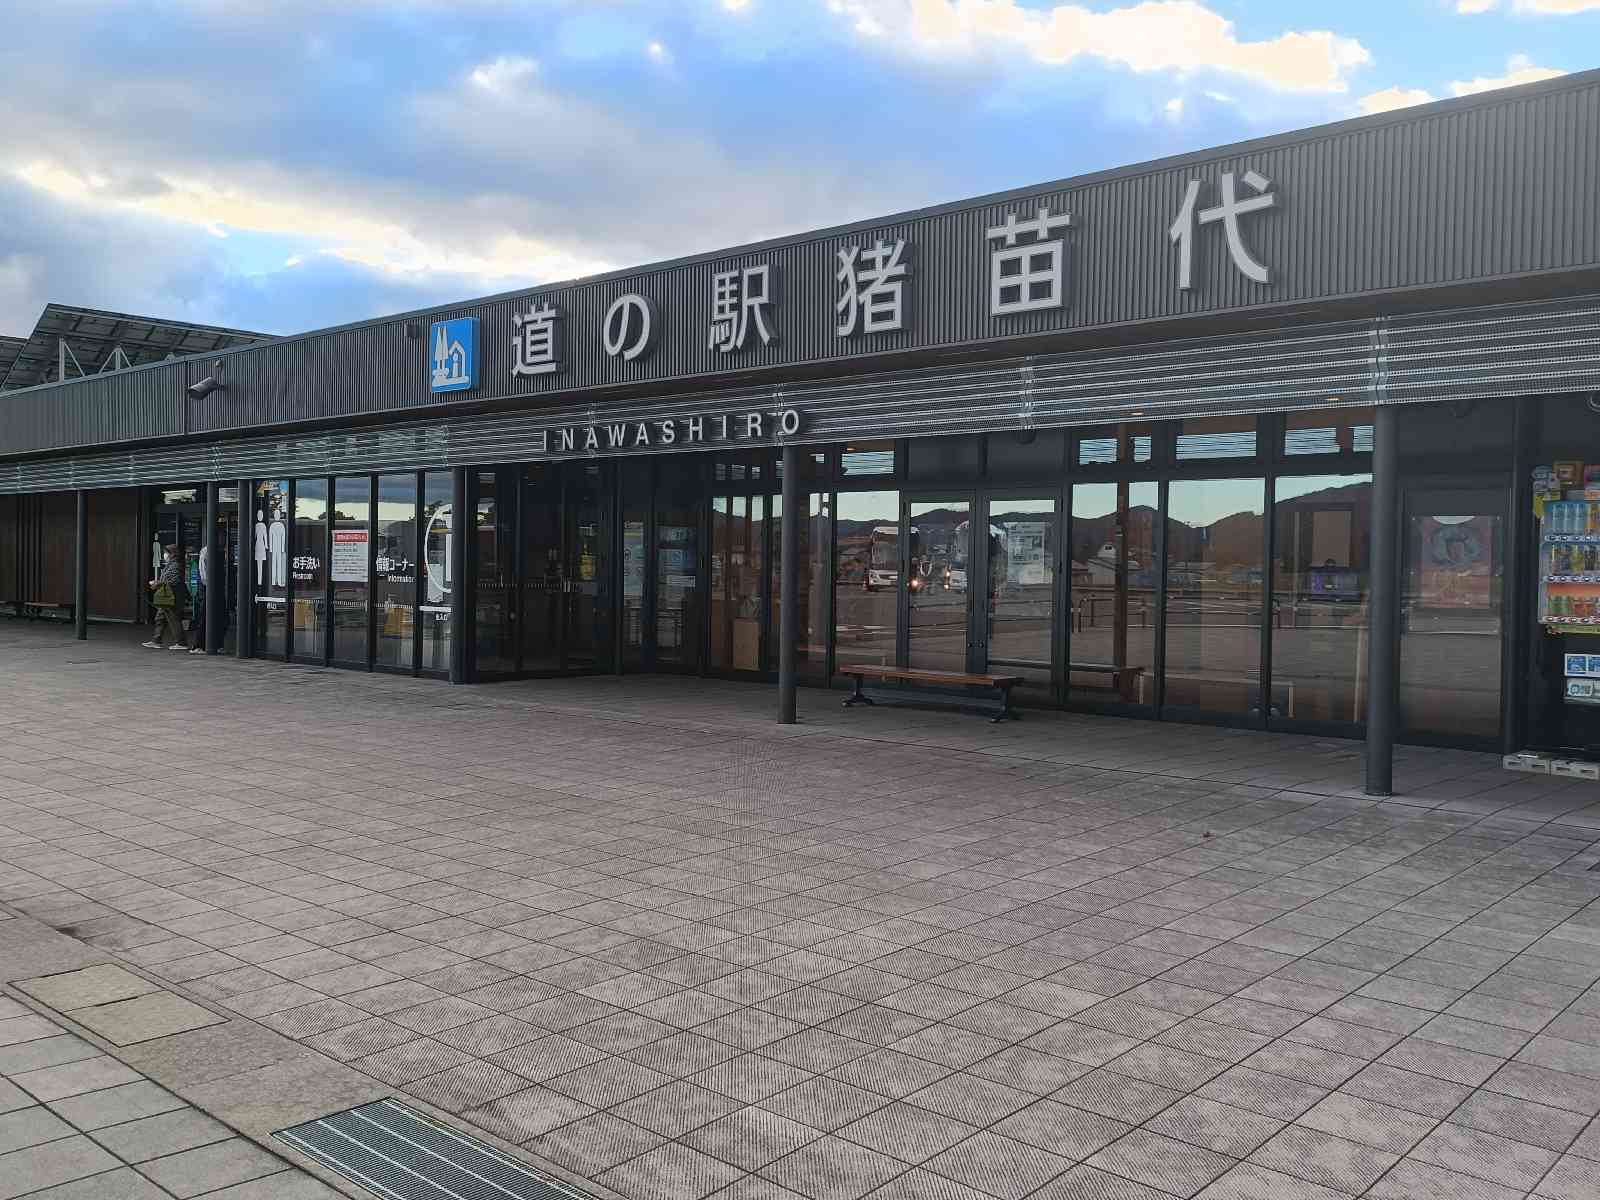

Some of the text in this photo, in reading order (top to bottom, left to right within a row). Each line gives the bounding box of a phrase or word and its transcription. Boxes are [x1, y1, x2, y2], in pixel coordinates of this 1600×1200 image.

[511, 168, 1277, 377] 道の駅猪苗代
[543, 409, 800, 450] INAWASHIRO
[293, 556, 320, 570] お手洗い
[376, 556, 415, 571] 情報コーナー
